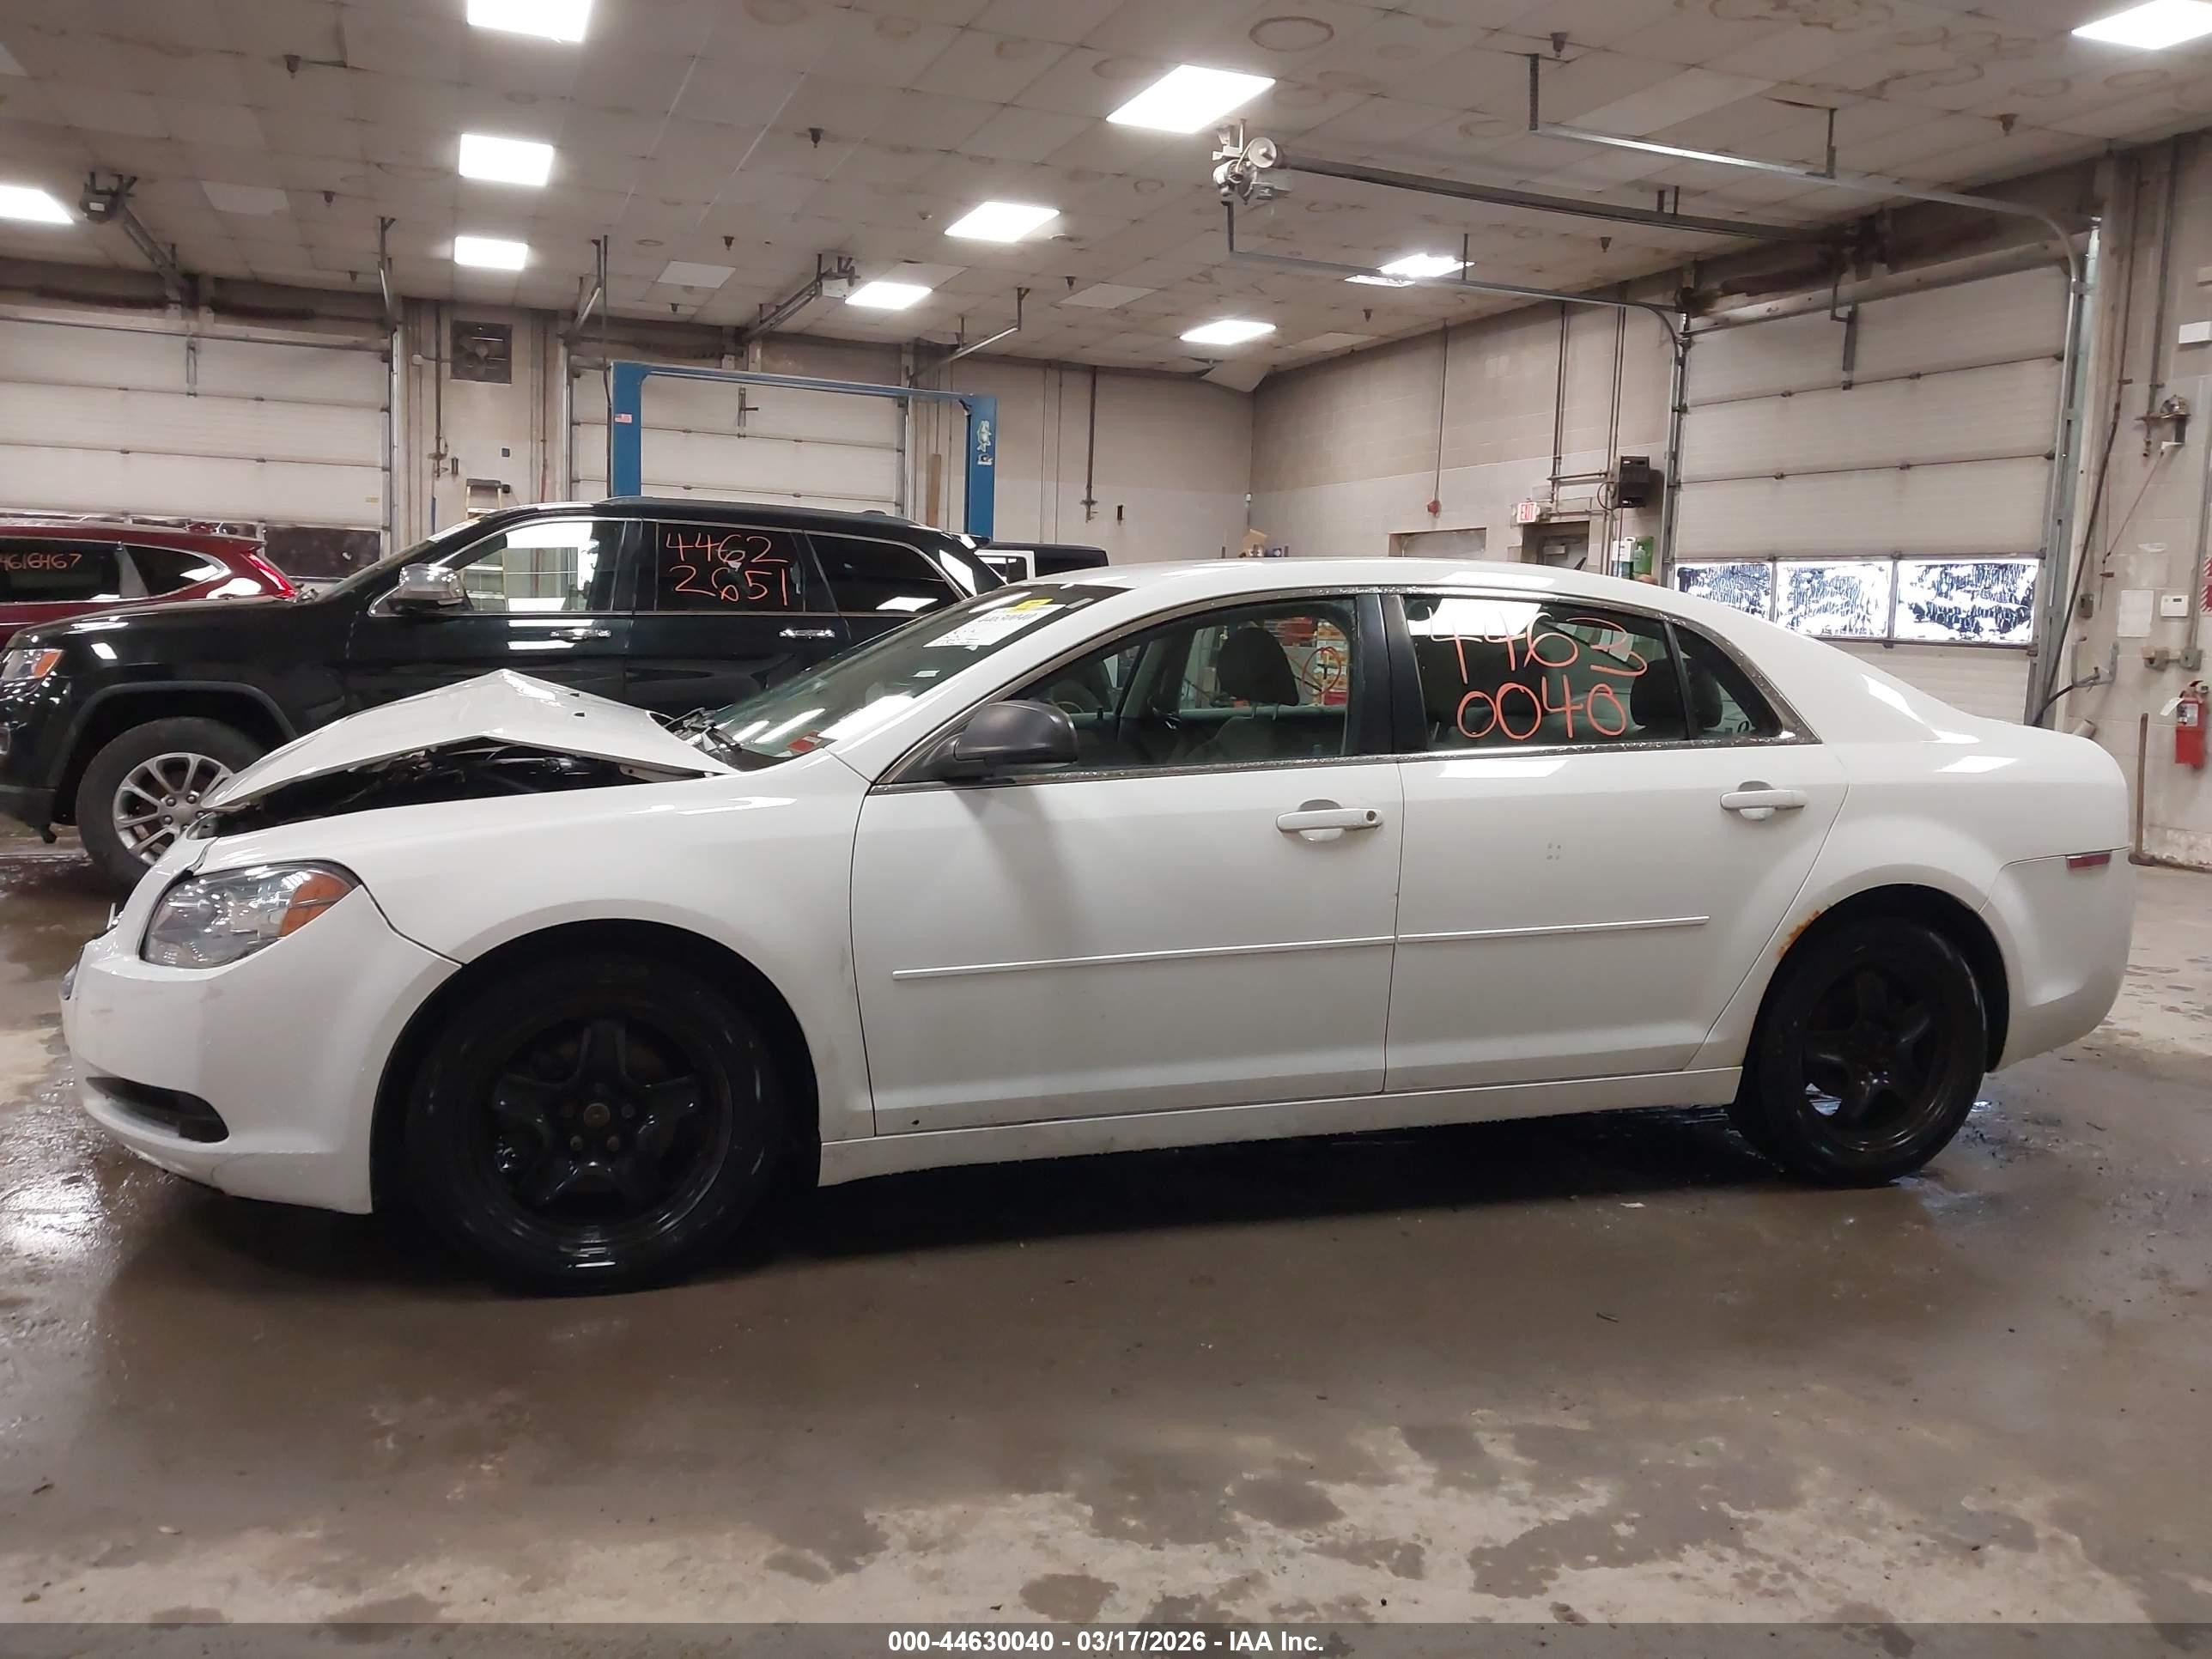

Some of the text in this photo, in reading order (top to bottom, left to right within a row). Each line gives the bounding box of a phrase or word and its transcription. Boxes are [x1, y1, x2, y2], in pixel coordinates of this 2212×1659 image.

[666, 532, 788, 563] 4462
[1427, 605, 1649, 684] 4463
[1457, 673, 1628, 740] 0040
